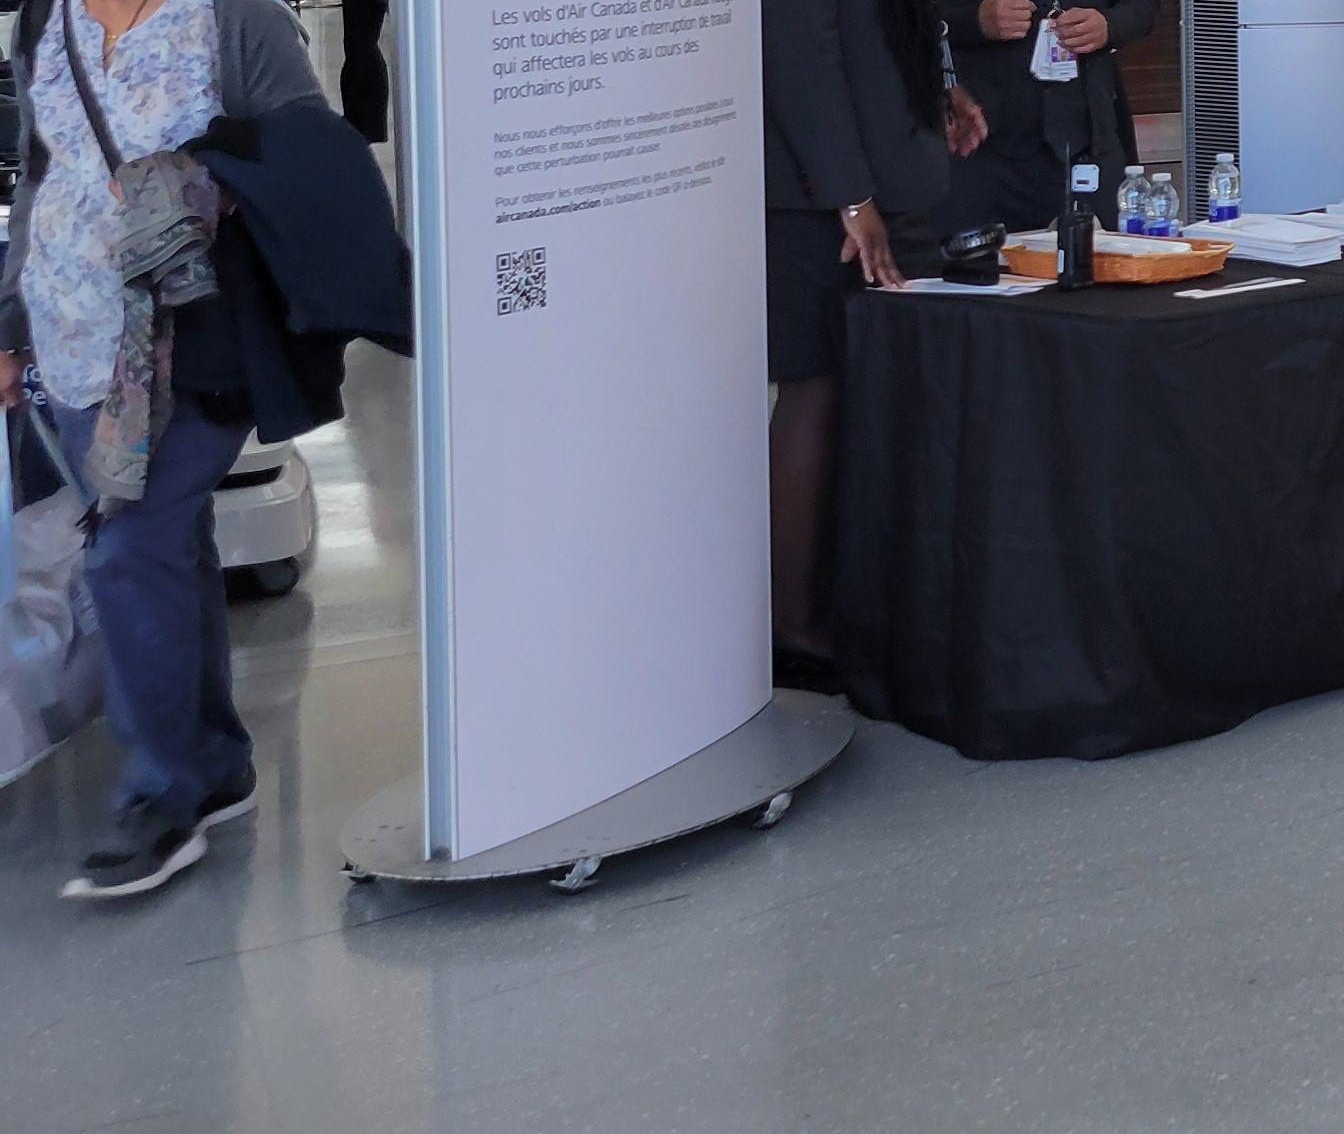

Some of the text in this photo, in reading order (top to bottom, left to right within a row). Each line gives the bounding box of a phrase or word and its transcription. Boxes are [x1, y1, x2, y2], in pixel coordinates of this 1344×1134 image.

[492, 10, 519, 25] Les
[523, 5, 552, 22] vols
[556, 3, 588, 21] d'Air
[591, 0, 637, 17] Canada
[640, 0, 652, 13] et
[492, 13, 709, 51] sont touchés par une interruption de
[493, 38, 700, 79] qui affectera les vols au cours des
[494, 76, 607, 105] prochains jours.
[494, 132, 520, 143] Nous
[523, 128, 547, 139] nous
[494, 149, 513, 160] nos
[515, 145, 547, 157] clients
[549, 142, 560, 152] et
[561, 140, 585, 150] nous
[494, 165, 515, 178] que
[517, 161, 542, 172] cette
[495, 196, 519, 208] Pour
[521, 189, 557, 204] obtenir
[558, 188, 572, 198] les
[496, 198, 601, 224] aircanada.com/action
